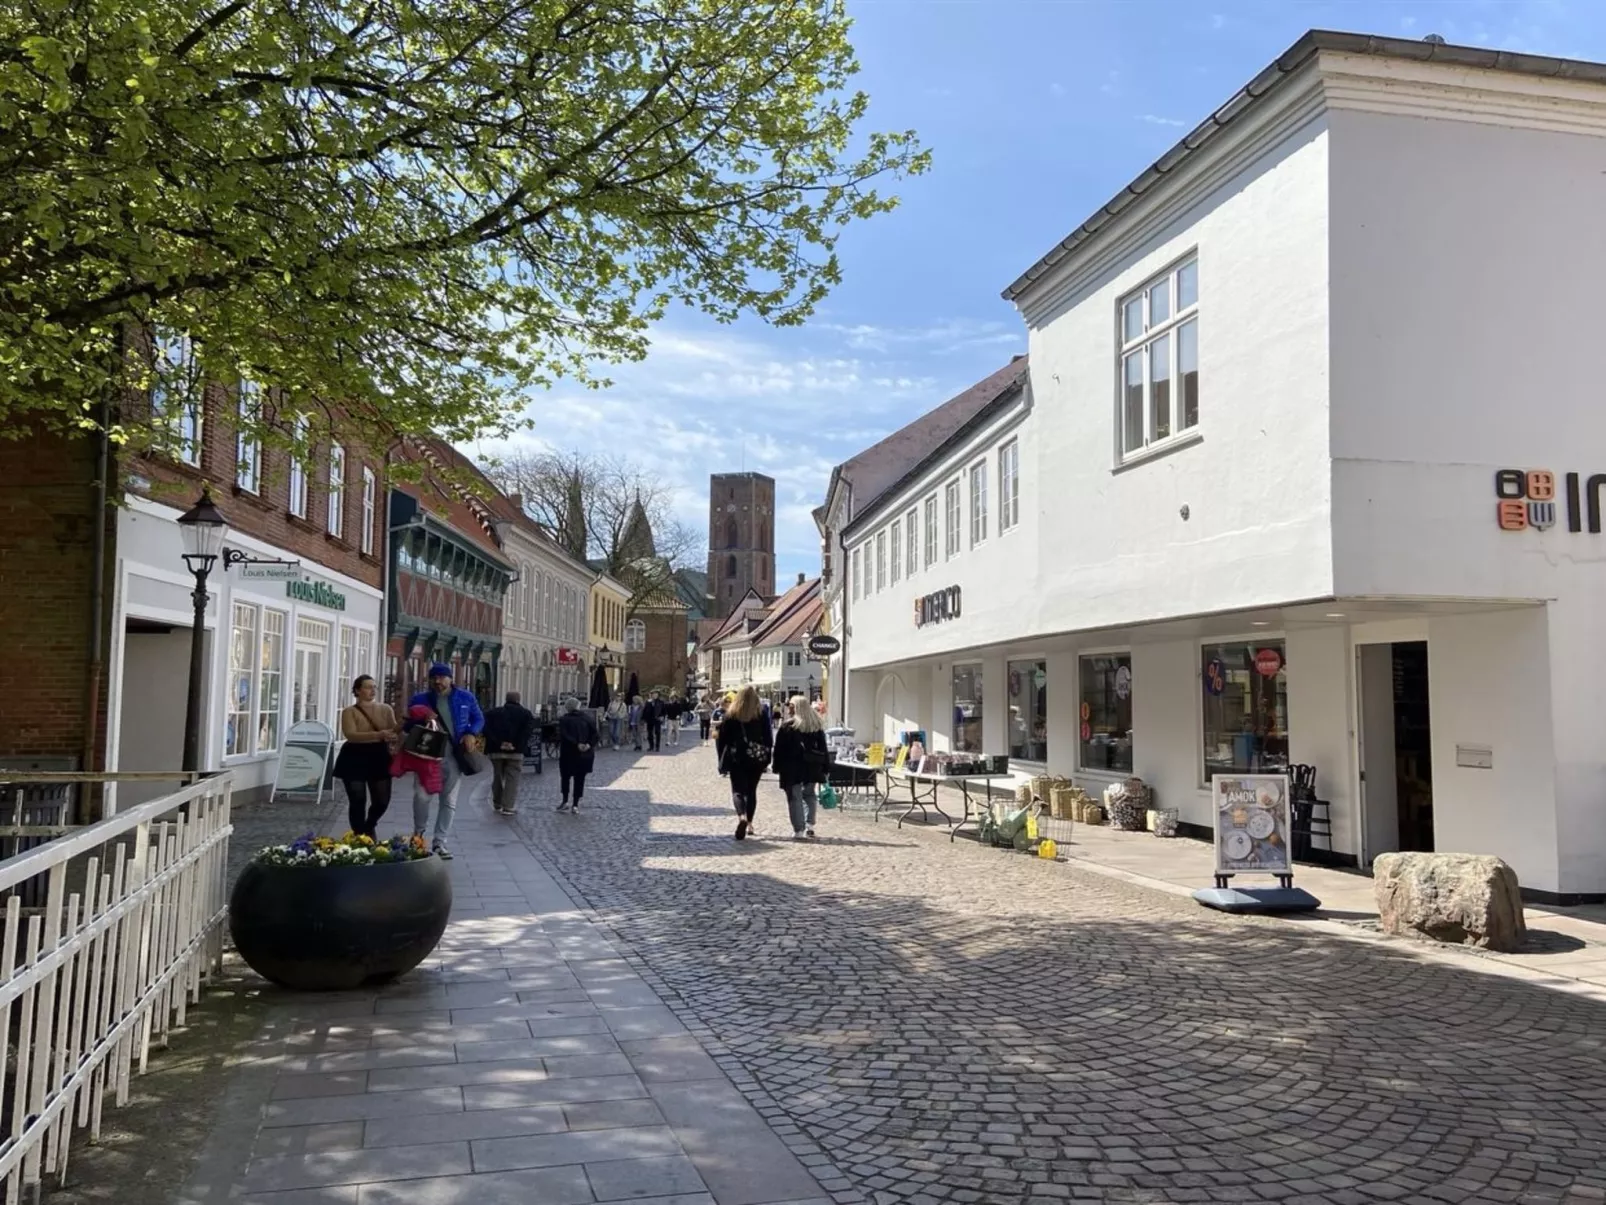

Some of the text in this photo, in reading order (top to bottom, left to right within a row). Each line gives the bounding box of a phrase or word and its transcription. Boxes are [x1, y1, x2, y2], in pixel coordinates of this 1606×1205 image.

[243, 569, 298, 577] Louis Nielsen
[1229, 791, 1256, 802] AMOK
